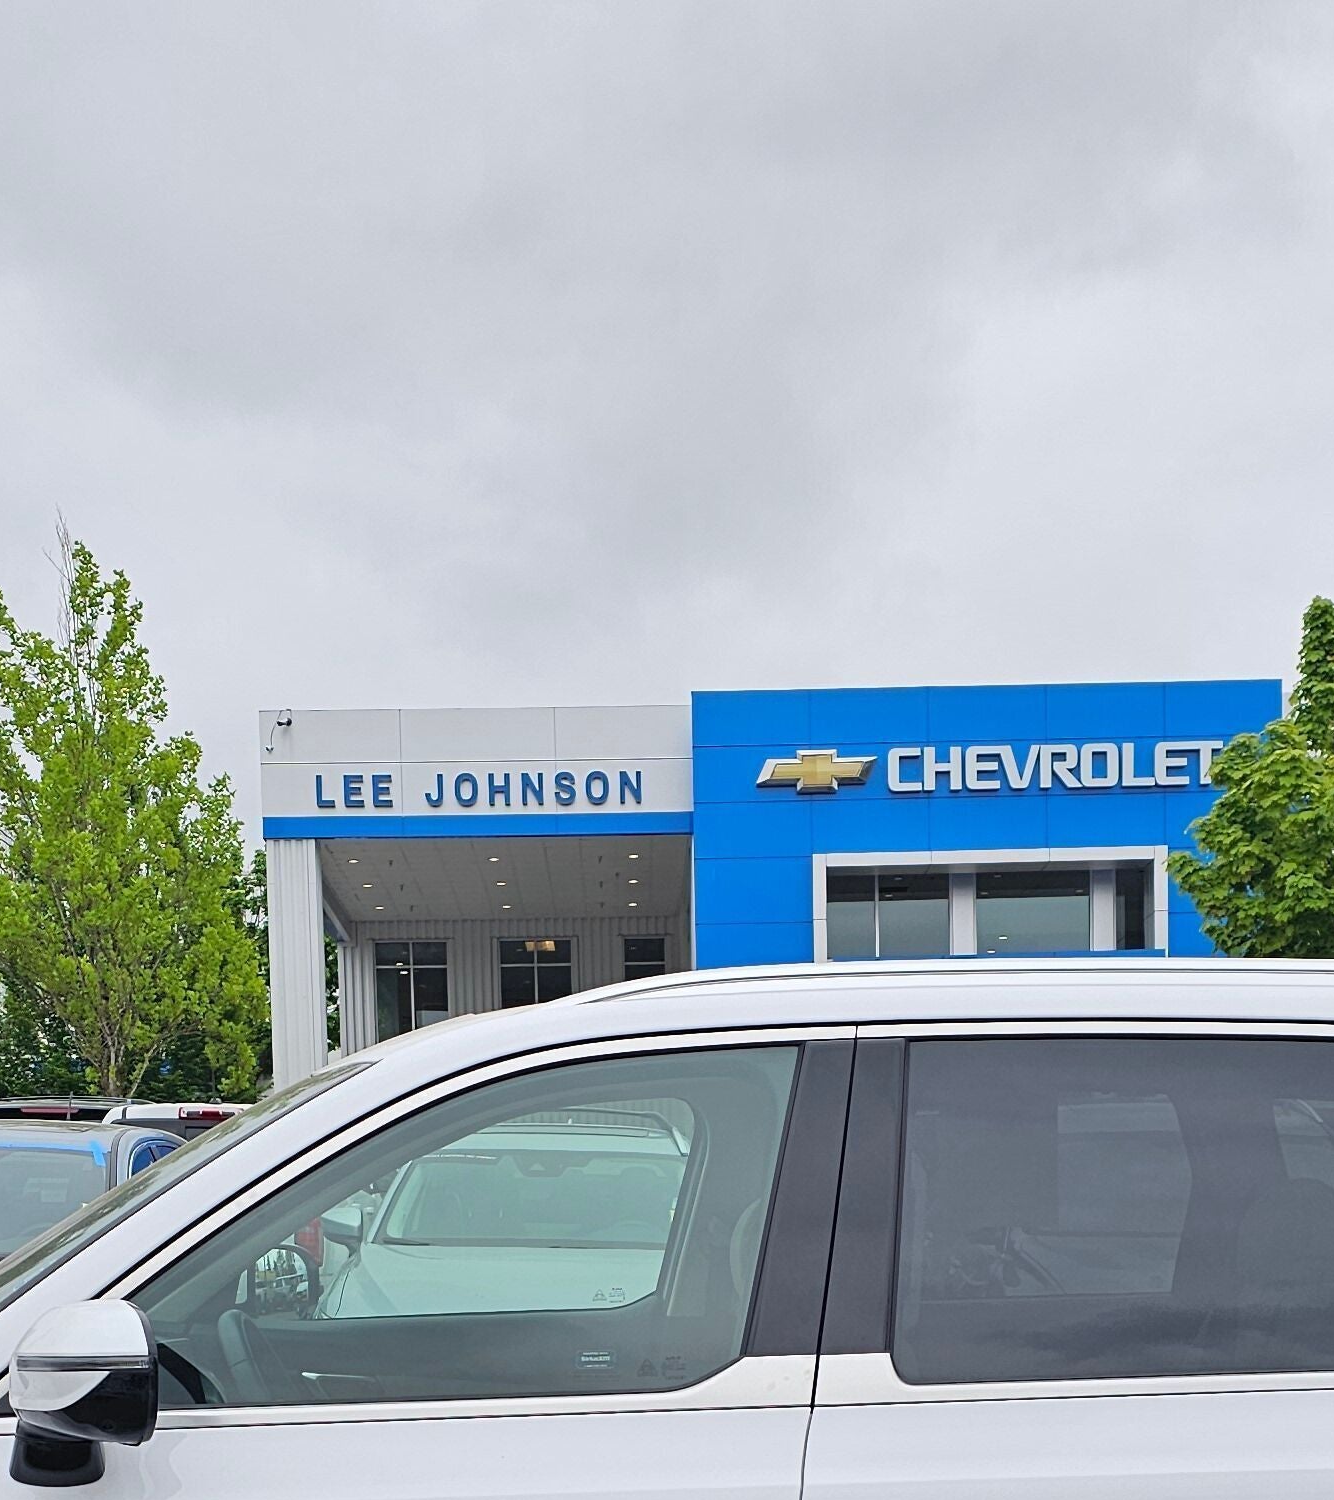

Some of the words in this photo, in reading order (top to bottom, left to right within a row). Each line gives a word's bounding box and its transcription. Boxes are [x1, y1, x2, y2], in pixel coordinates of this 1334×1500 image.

[887, 740, 1223, 792] CHEVROLET
[315, 774, 393, 808] LEE
[425, 770, 642, 808] JOHNSON
